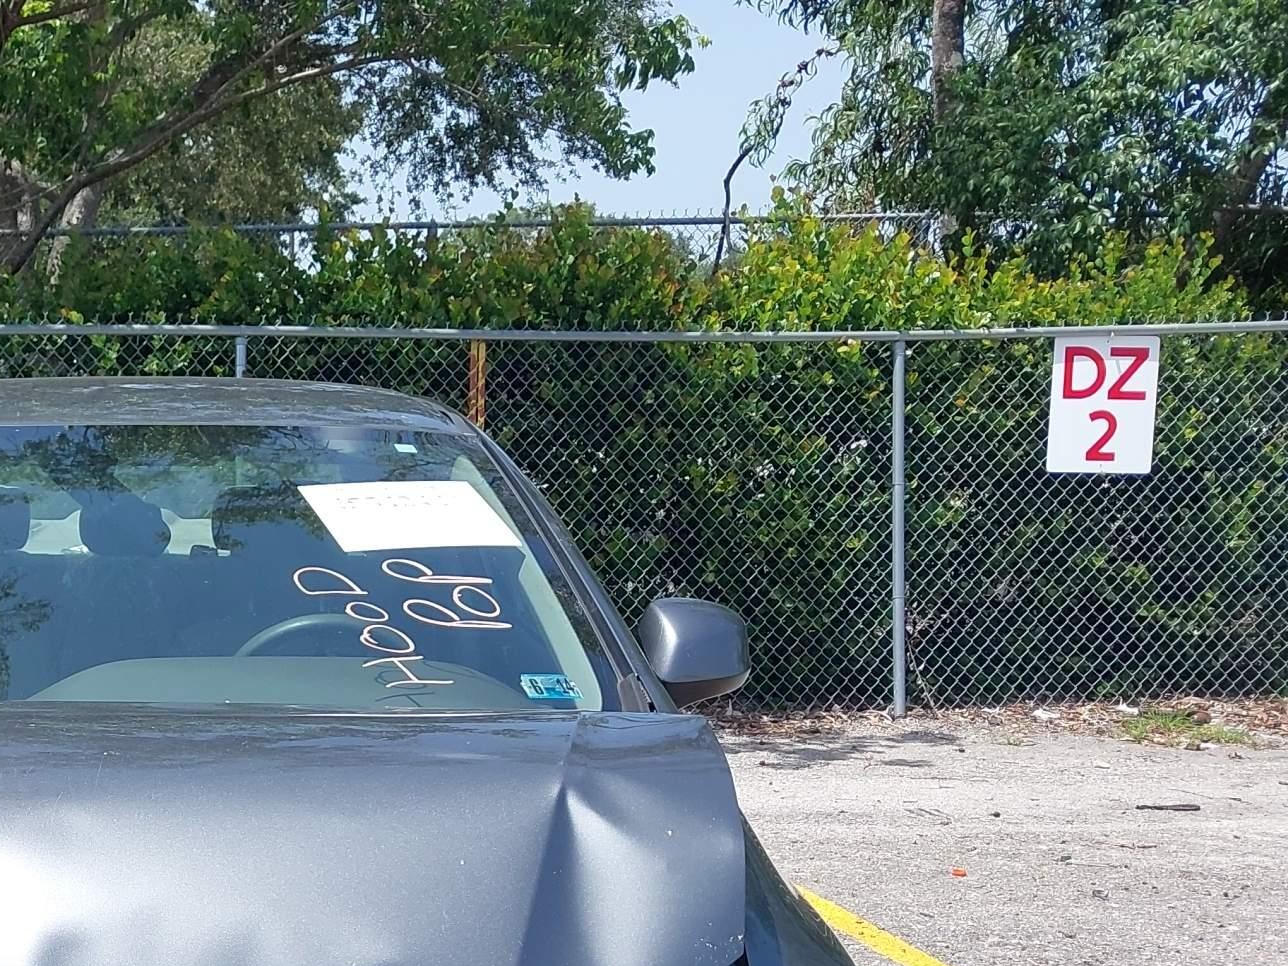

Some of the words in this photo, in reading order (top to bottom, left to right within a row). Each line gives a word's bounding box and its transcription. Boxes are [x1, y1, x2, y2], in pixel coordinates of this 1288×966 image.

[1062, 346, 1151, 400] DZ
[1085, 409, 1118, 462] 2
[381, 557, 513, 629] POP
[292, 566, 455, 689] HOOD
